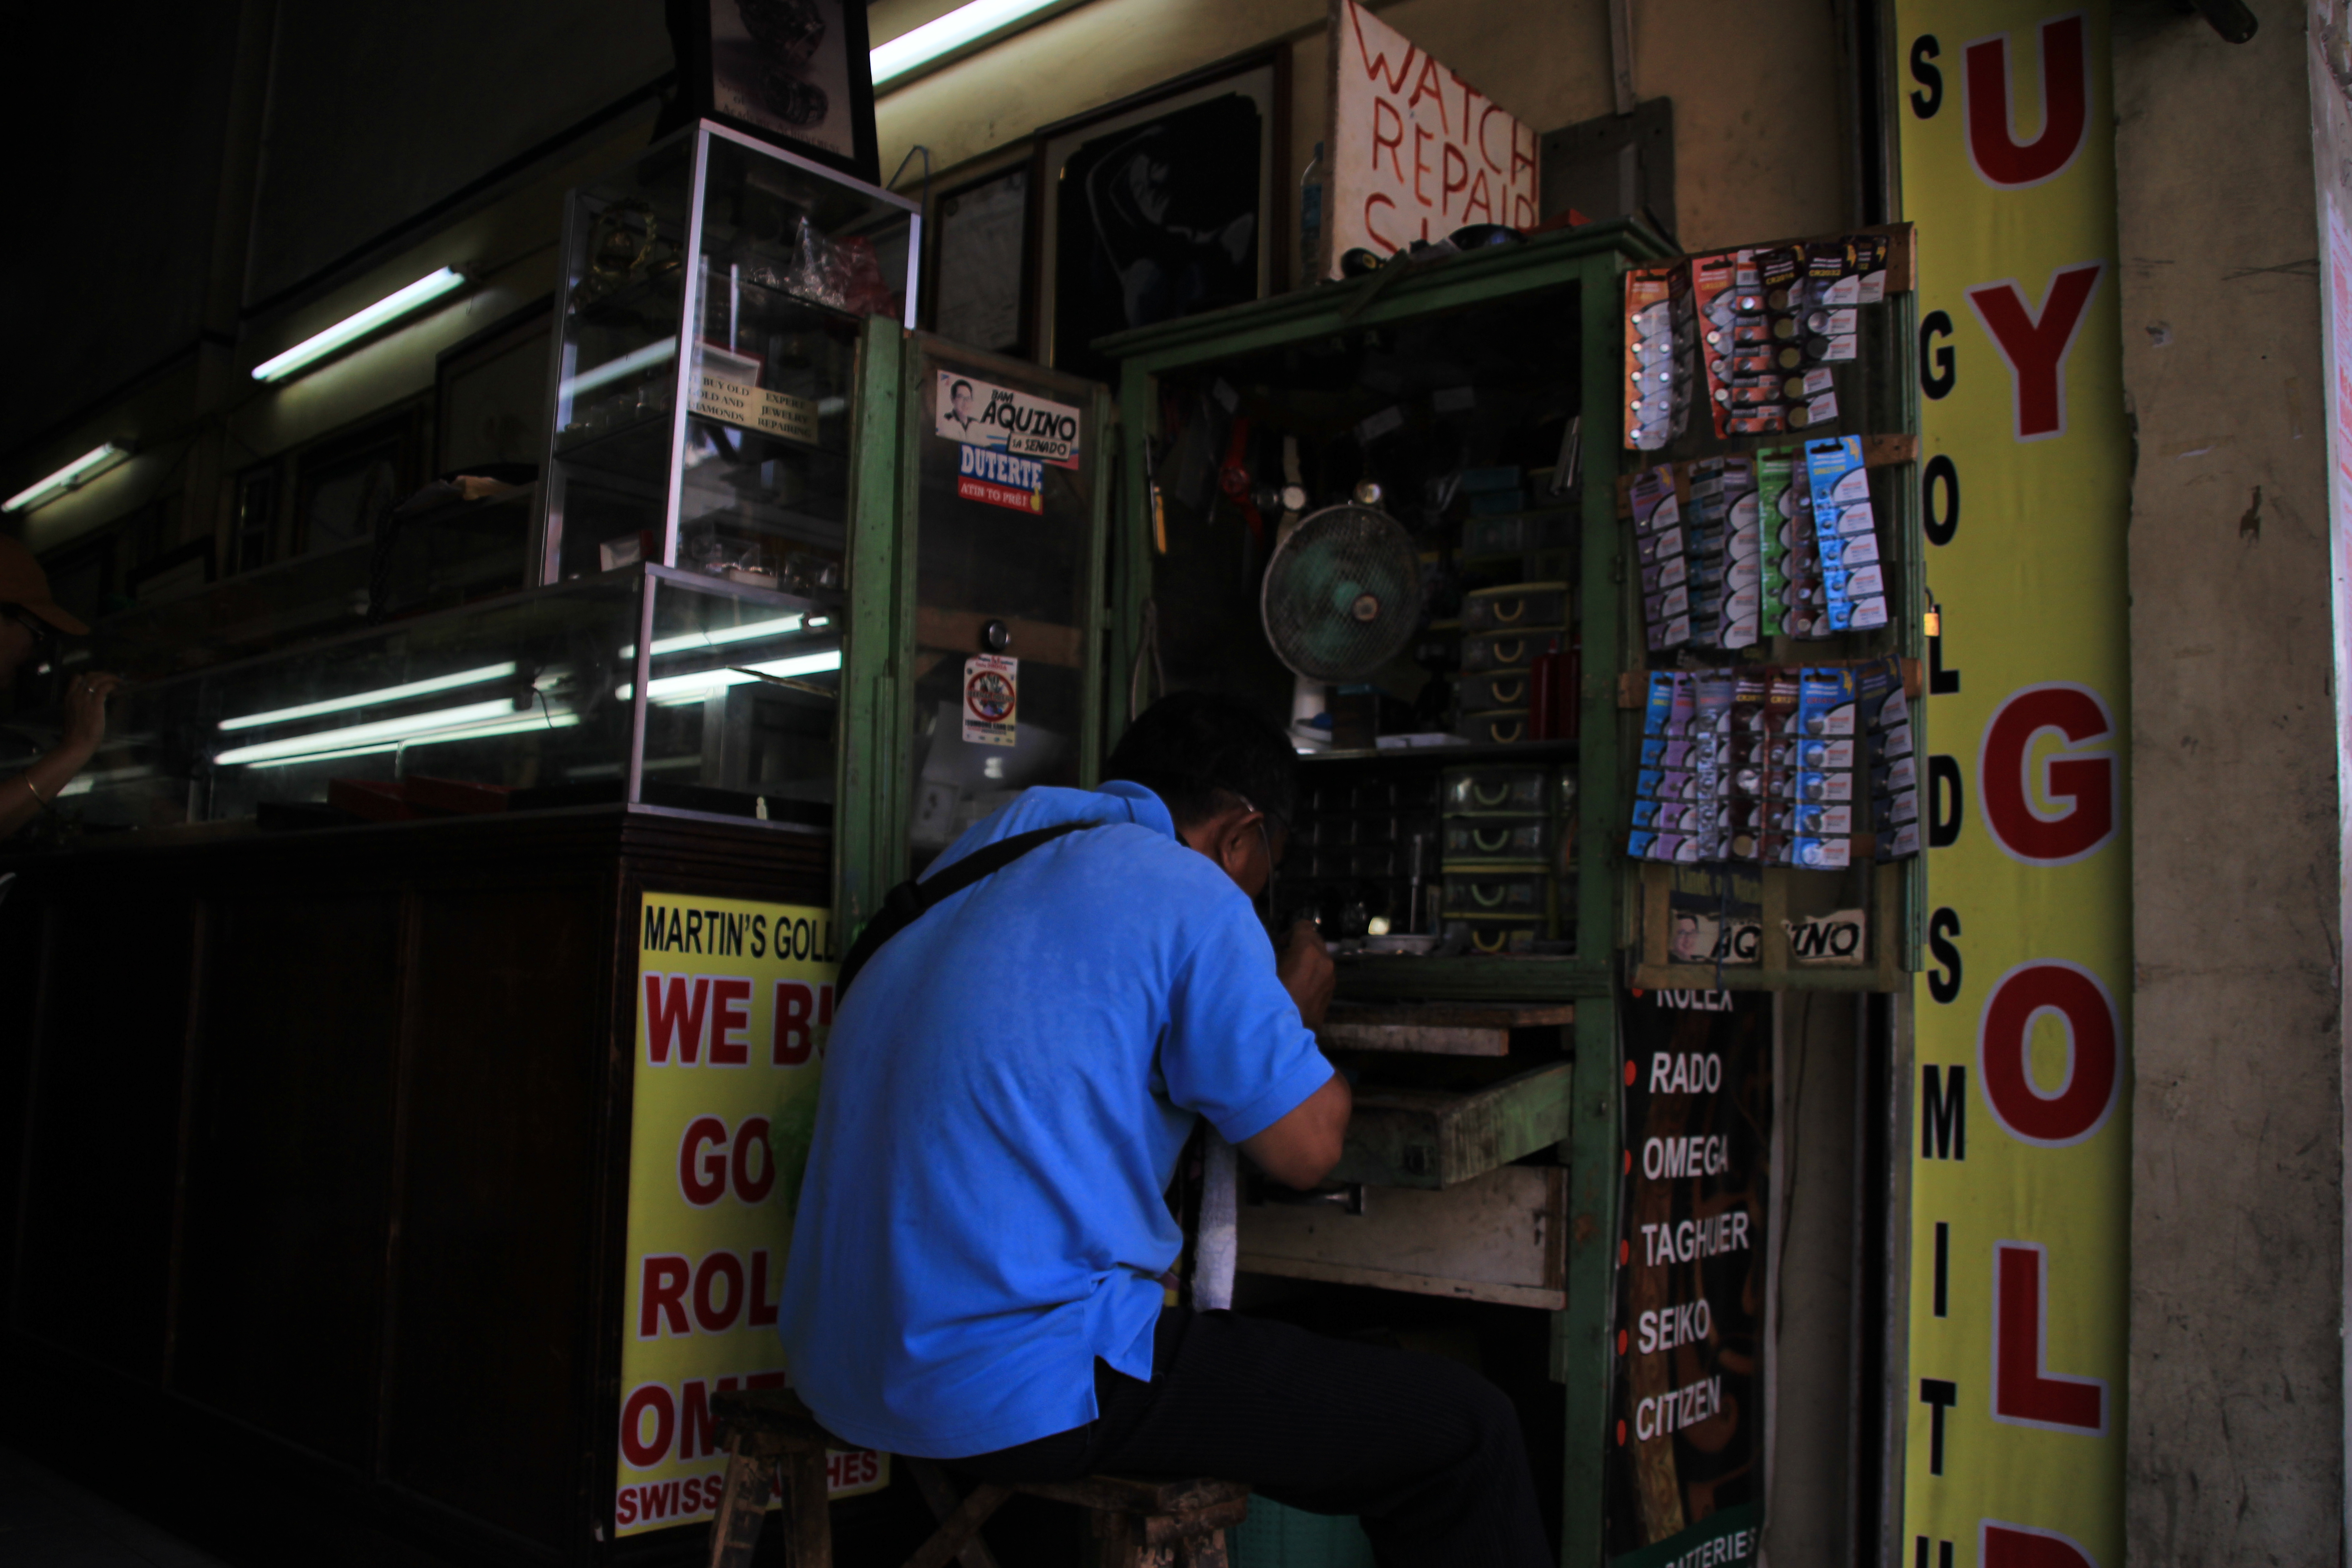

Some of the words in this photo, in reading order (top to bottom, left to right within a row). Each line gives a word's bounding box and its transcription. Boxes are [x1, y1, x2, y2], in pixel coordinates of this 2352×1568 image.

[1347, 0, 1537, 203] WATCH
[703, 377, 724, 390] BUY
[727, 384, 750, 397] OLD
[721, 397, 744, 408] AND
[765, 392, 805, 408] EXPERT
[991, 389, 1014, 403] BAM
[758, 417, 812, 438] REPAIRING
[761, 406, 808, 423] JEWELRY
[980, 401, 1076, 441] AQUINO
[960, 444, 1043, 490] DUTERTE
[1025, 438, 1067, 456] SENADO
[960, 482, 985, 496] ATIN
[987, 487, 1001, 500] TO
[643, 905, 766, 958] MARTIN'S
[645, 975, 751, 1064] WE
[1648, 1051, 1722, 1094] RADO
[1981, 685, 2118, 1568] GOL
[1642, 1134, 1730, 1180] OMEGA
[1640, 1210, 1750, 1267] TAGHUER
[1637, 1298, 1711, 1355] SEIKO
[1635, 1373, 1722, 1442] CITIZEN
[617, 1475, 723, 1525] SWISS
